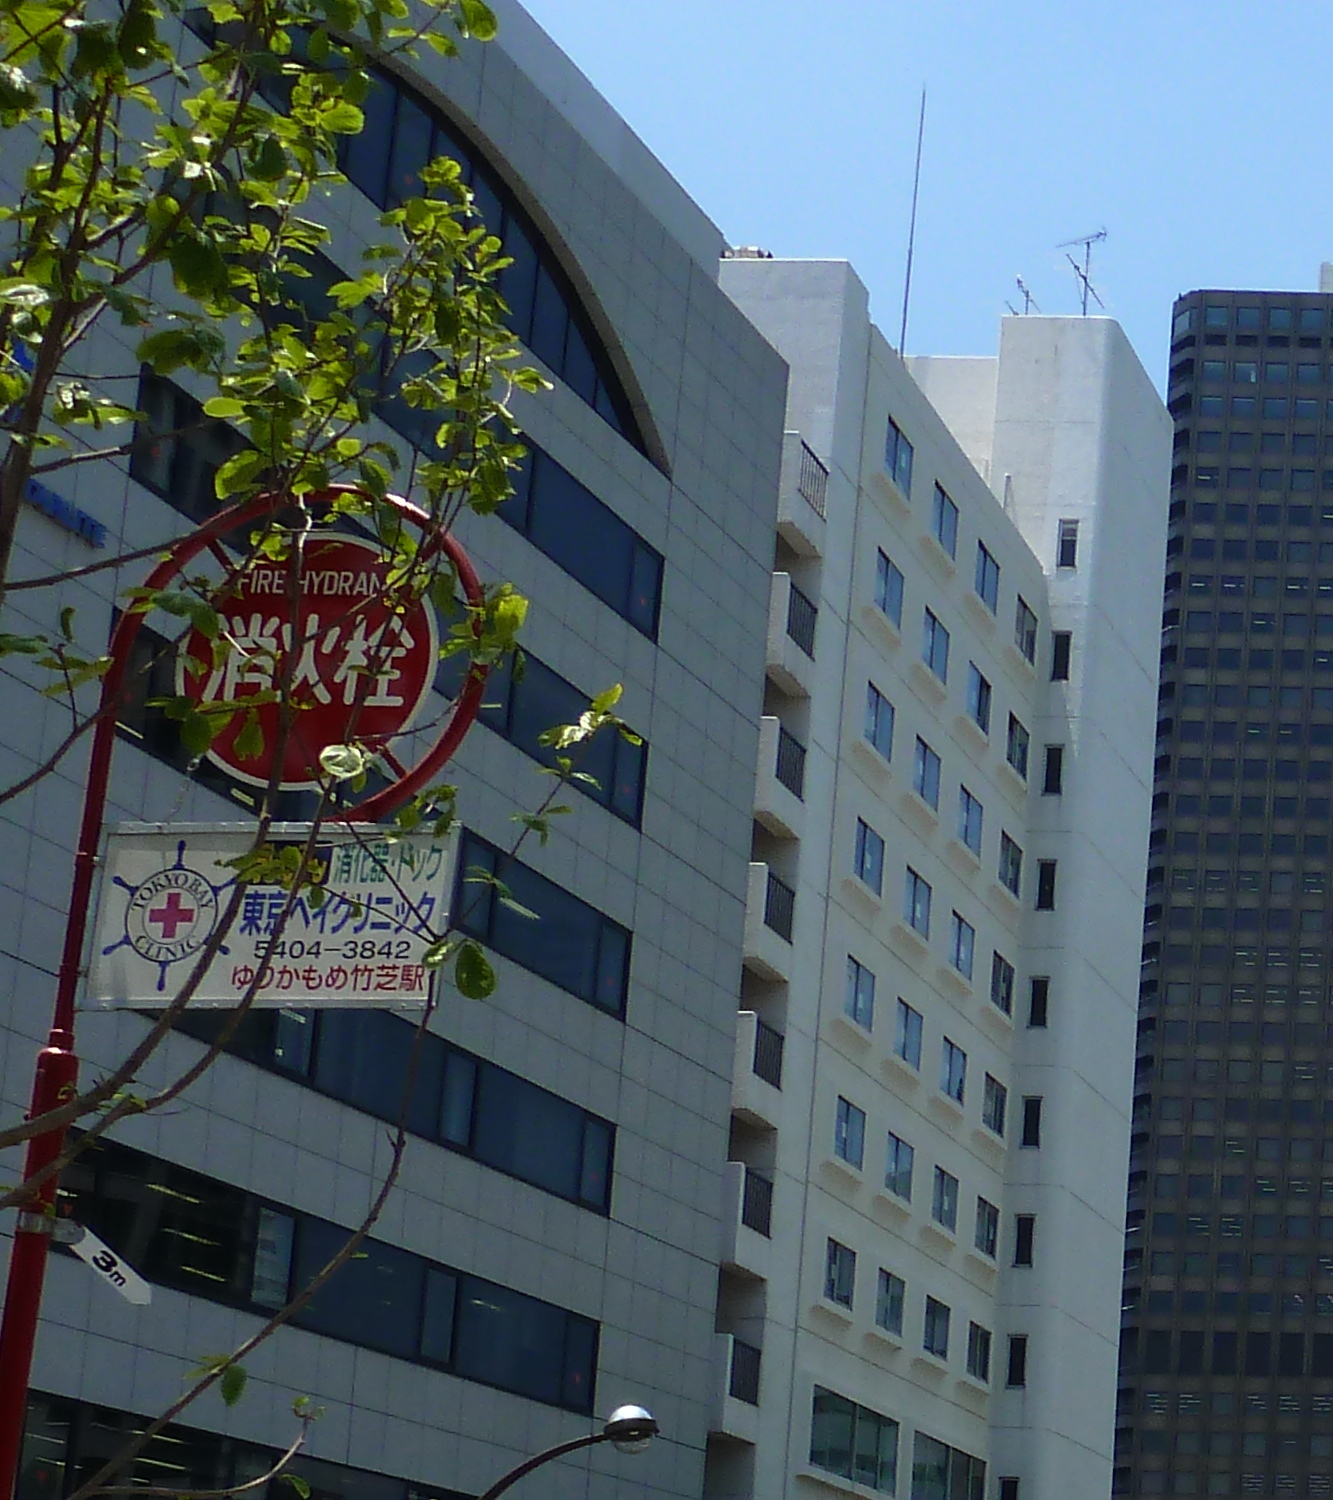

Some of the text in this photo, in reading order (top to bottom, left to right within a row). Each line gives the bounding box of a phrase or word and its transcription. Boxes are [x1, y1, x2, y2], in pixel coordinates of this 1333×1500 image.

[237, 569, 394, 598] FIRE HYDRAN
[203, 612, 416, 706] 消火栓
[130, 872, 215, 912] TOKYO BAY
[135, 935, 202, 960] CLINIC
